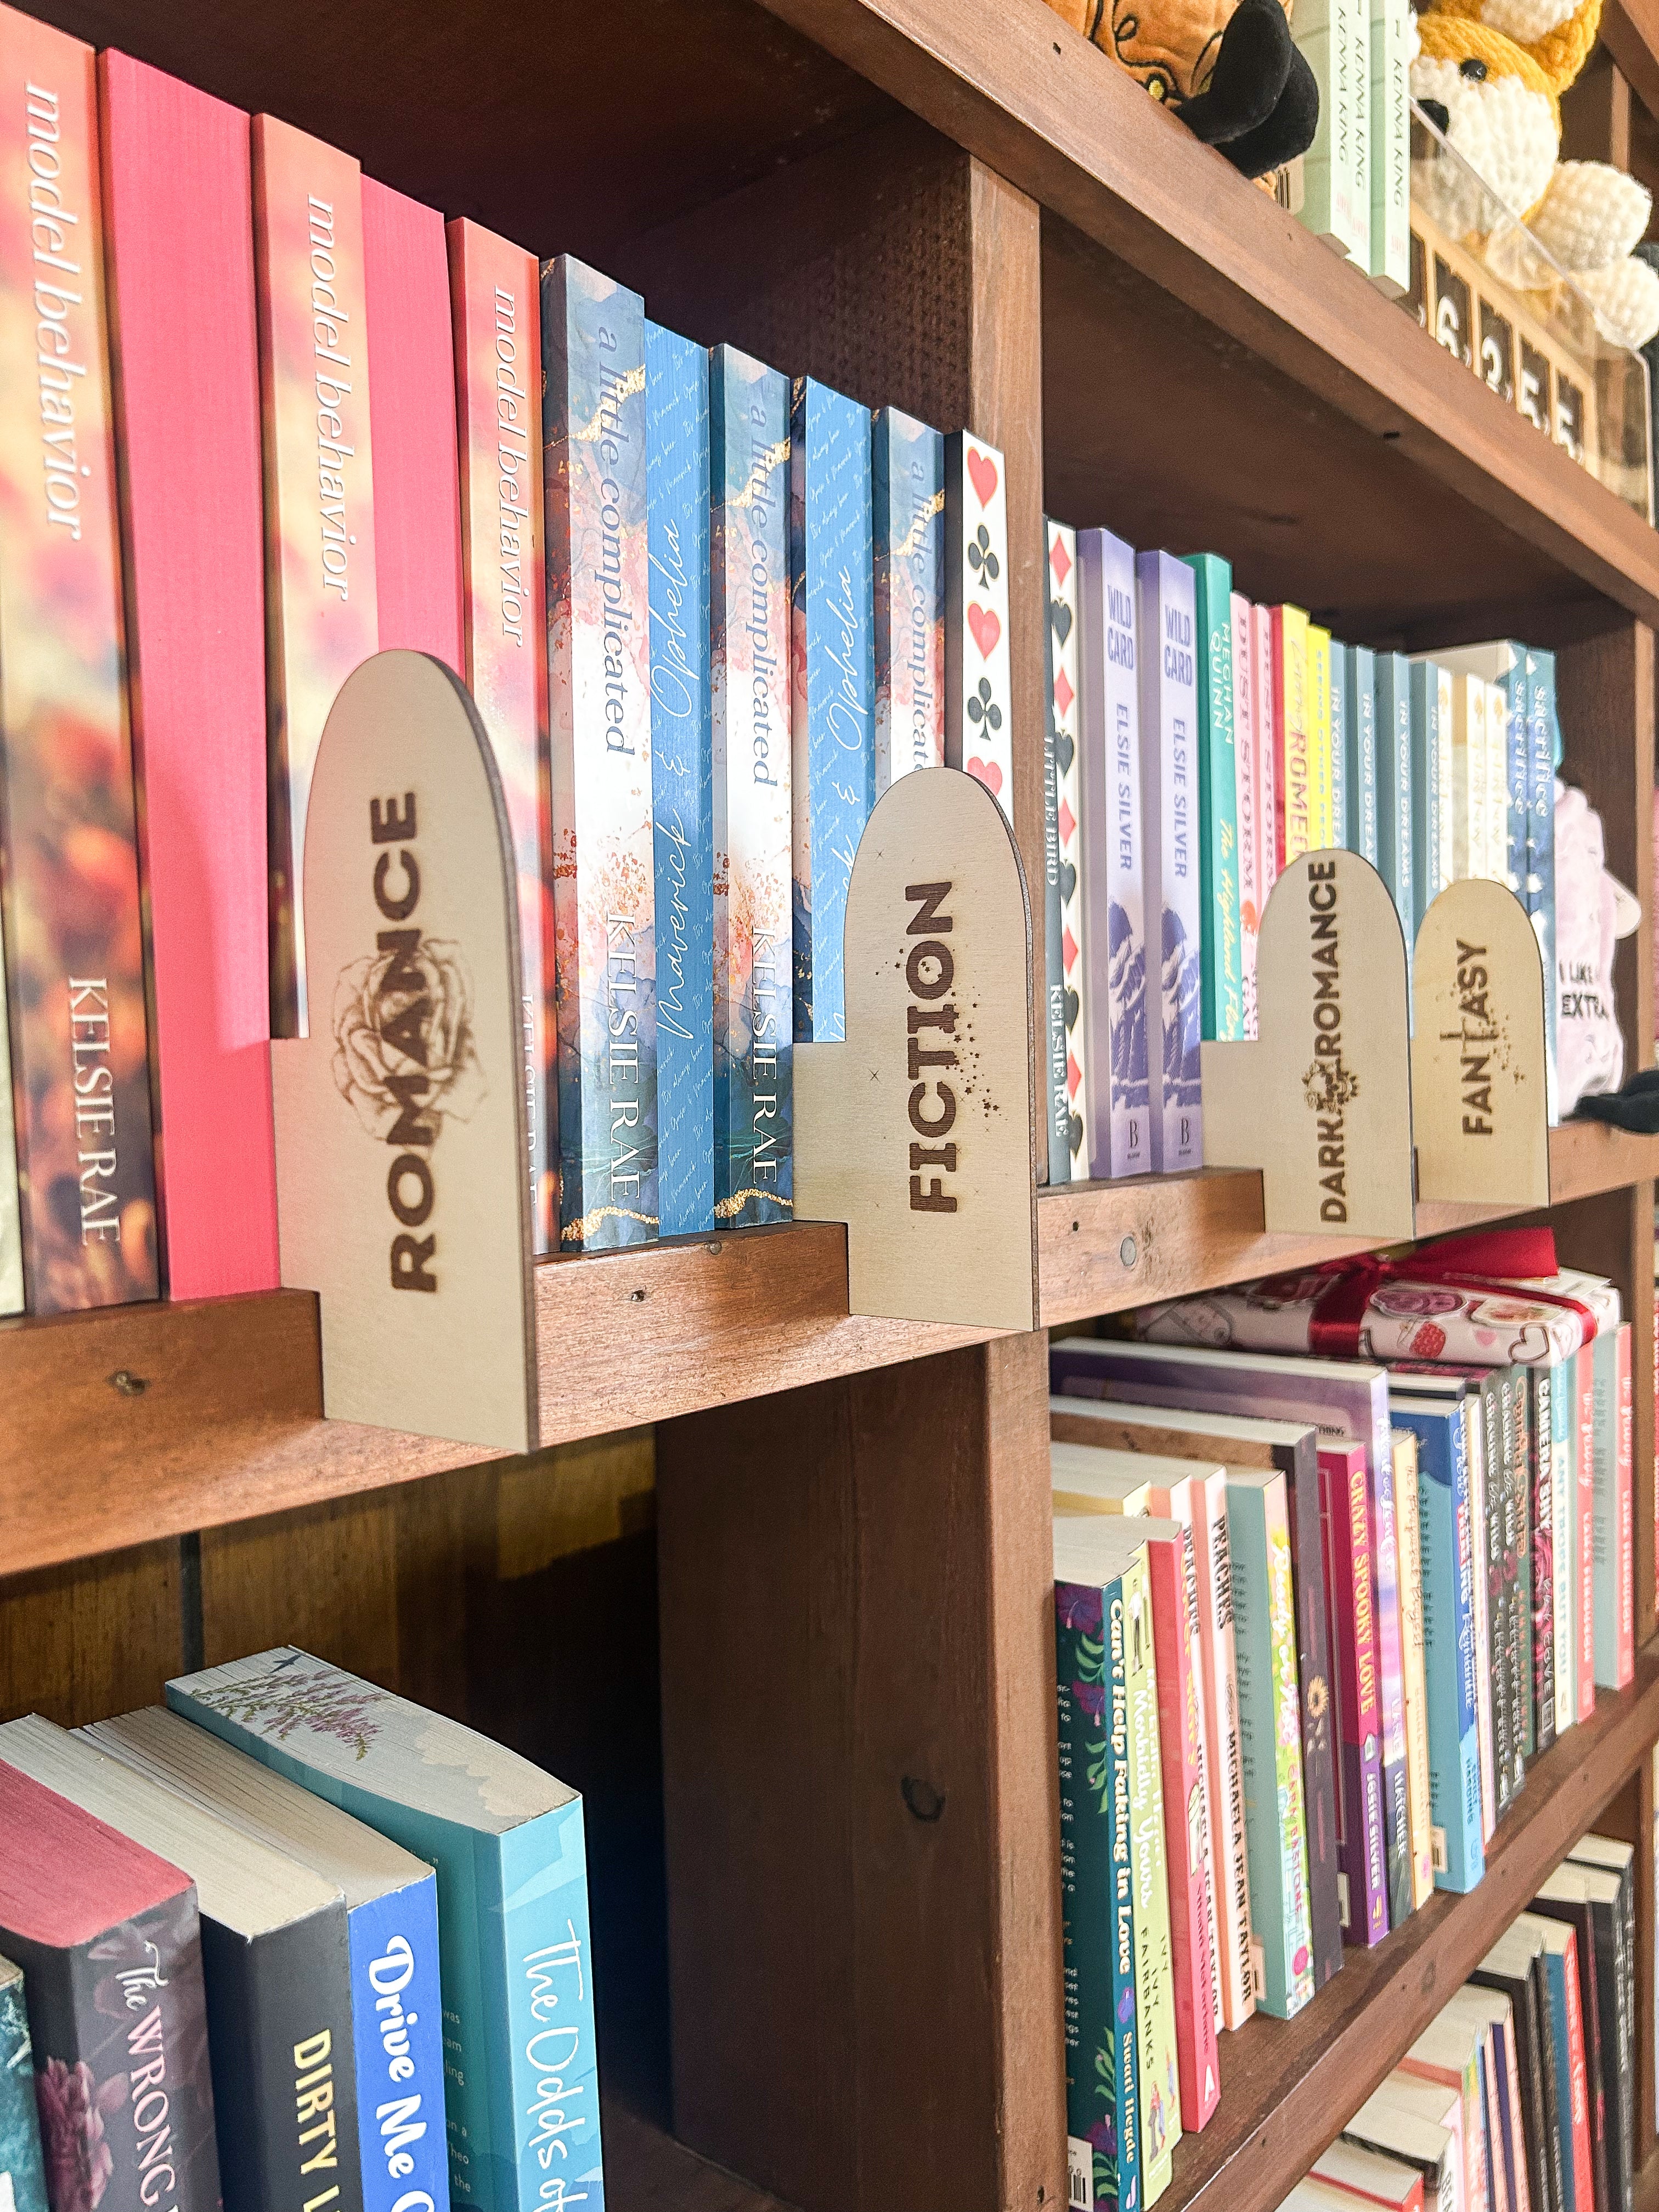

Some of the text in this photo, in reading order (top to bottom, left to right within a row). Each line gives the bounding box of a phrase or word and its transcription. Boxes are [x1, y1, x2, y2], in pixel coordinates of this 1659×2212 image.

[1338, 7, 1348, 165] KENNA KING
[1355, 37, 1365, 190] KENNA KING
[1393, 59, 1406, 208] KENNA KING
[24, 81, 91, 540] model behavior
[307, 194, 358, 601] model behavior
[493, 285, 531, 647] model behavior
[911, 460, 924, 482] a
[594, 326, 635, 755] a little complicated
[746, 404, 777, 787] a little complicated
[912, 495, 933, 574] little
[1108, 585, 1132, 630] WILD
[648, 519, 699, 717] Ophelia
[825, 566, 867, 751] Ophelia
[1108, 626, 1133, 670] CARD
[1164, 644, 1193, 687] CARD
[1165, 604, 1191, 648] WILD
[1210, 631, 1224, 729] QUINN
[1222, 622, 1234, 744] MEGHAN
[1238, 616, 1254, 890] DUST STORM
[1330, 686, 1341, 712] IN
[1331, 719, 1342, 780] YOUR
[1363, 692, 1373, 785] IN YOUR
[1431, 706, 1438, 730] IN
[1534, 686, 1552, 817] sacrifice
[1045, 826, 1059, 887] BIRD
[1116, 703, 1133, 870] ELSIE SILVER
[1173, 718, 1188, 878] ELSIE SILVER
[1220, 818, 1234, 860] The
[1289, 731, 1308, 856] ROMEO
[1400, 700, 1410, 888] IN YOUR DREAMS
[1431, 800, 1439, 890] DREAMS
[657, 809, 693, 1040] Maverick
[69, 977, 121, 1246] KELSIE RAE
[370, 791, 441, 1293] ROMANCE
[606, 911, 640, 1201] KELSIE RAE
[752, 927, 778, 1184] KELSIE RAE
[905, 882, 958, 1213] FICTION
[1049, 983, 1068, 1138] KELSIE RAE
[1307, 860, 1347, 1223] DARK ROMANCE
[1444, 938, 1498, 1137] FANTASY
[1539, 1379, 1553, 1531] CAMERA SHY
[1212, 1515, 1234, 1629] PEACHES
[1350, 1470, 1375, 1716] CRAZY SPOOKY LOVE
[1110, 1598, 1132, 1975] Can't Help Faking in Love
[1132, 1689, 1154, 1909] Morbidly Yours
[1367, 1773, 1381, 1891] JOSIE SILVER
[1226, 1730, 1251, 2005] MICHAELA JEAN TAYLOR
[115, 1940, 169, 2010] The
[368, 1934, 418, 2084] Drive
[522, 1918, 584, 2023] The
[1141, 1926, 1155, 2070] FAIRBANKS
[1150, 1966, 1160, 2007] IVY
[127, 2005, 177, 2207] WRONG
[294, 2029, 338, 2175] DIRTY
[375, 2093, 427, 2179] Me
[526, 2027, 586, 2170] Odds
[1122, 2031, 1135, 2095] Swati
